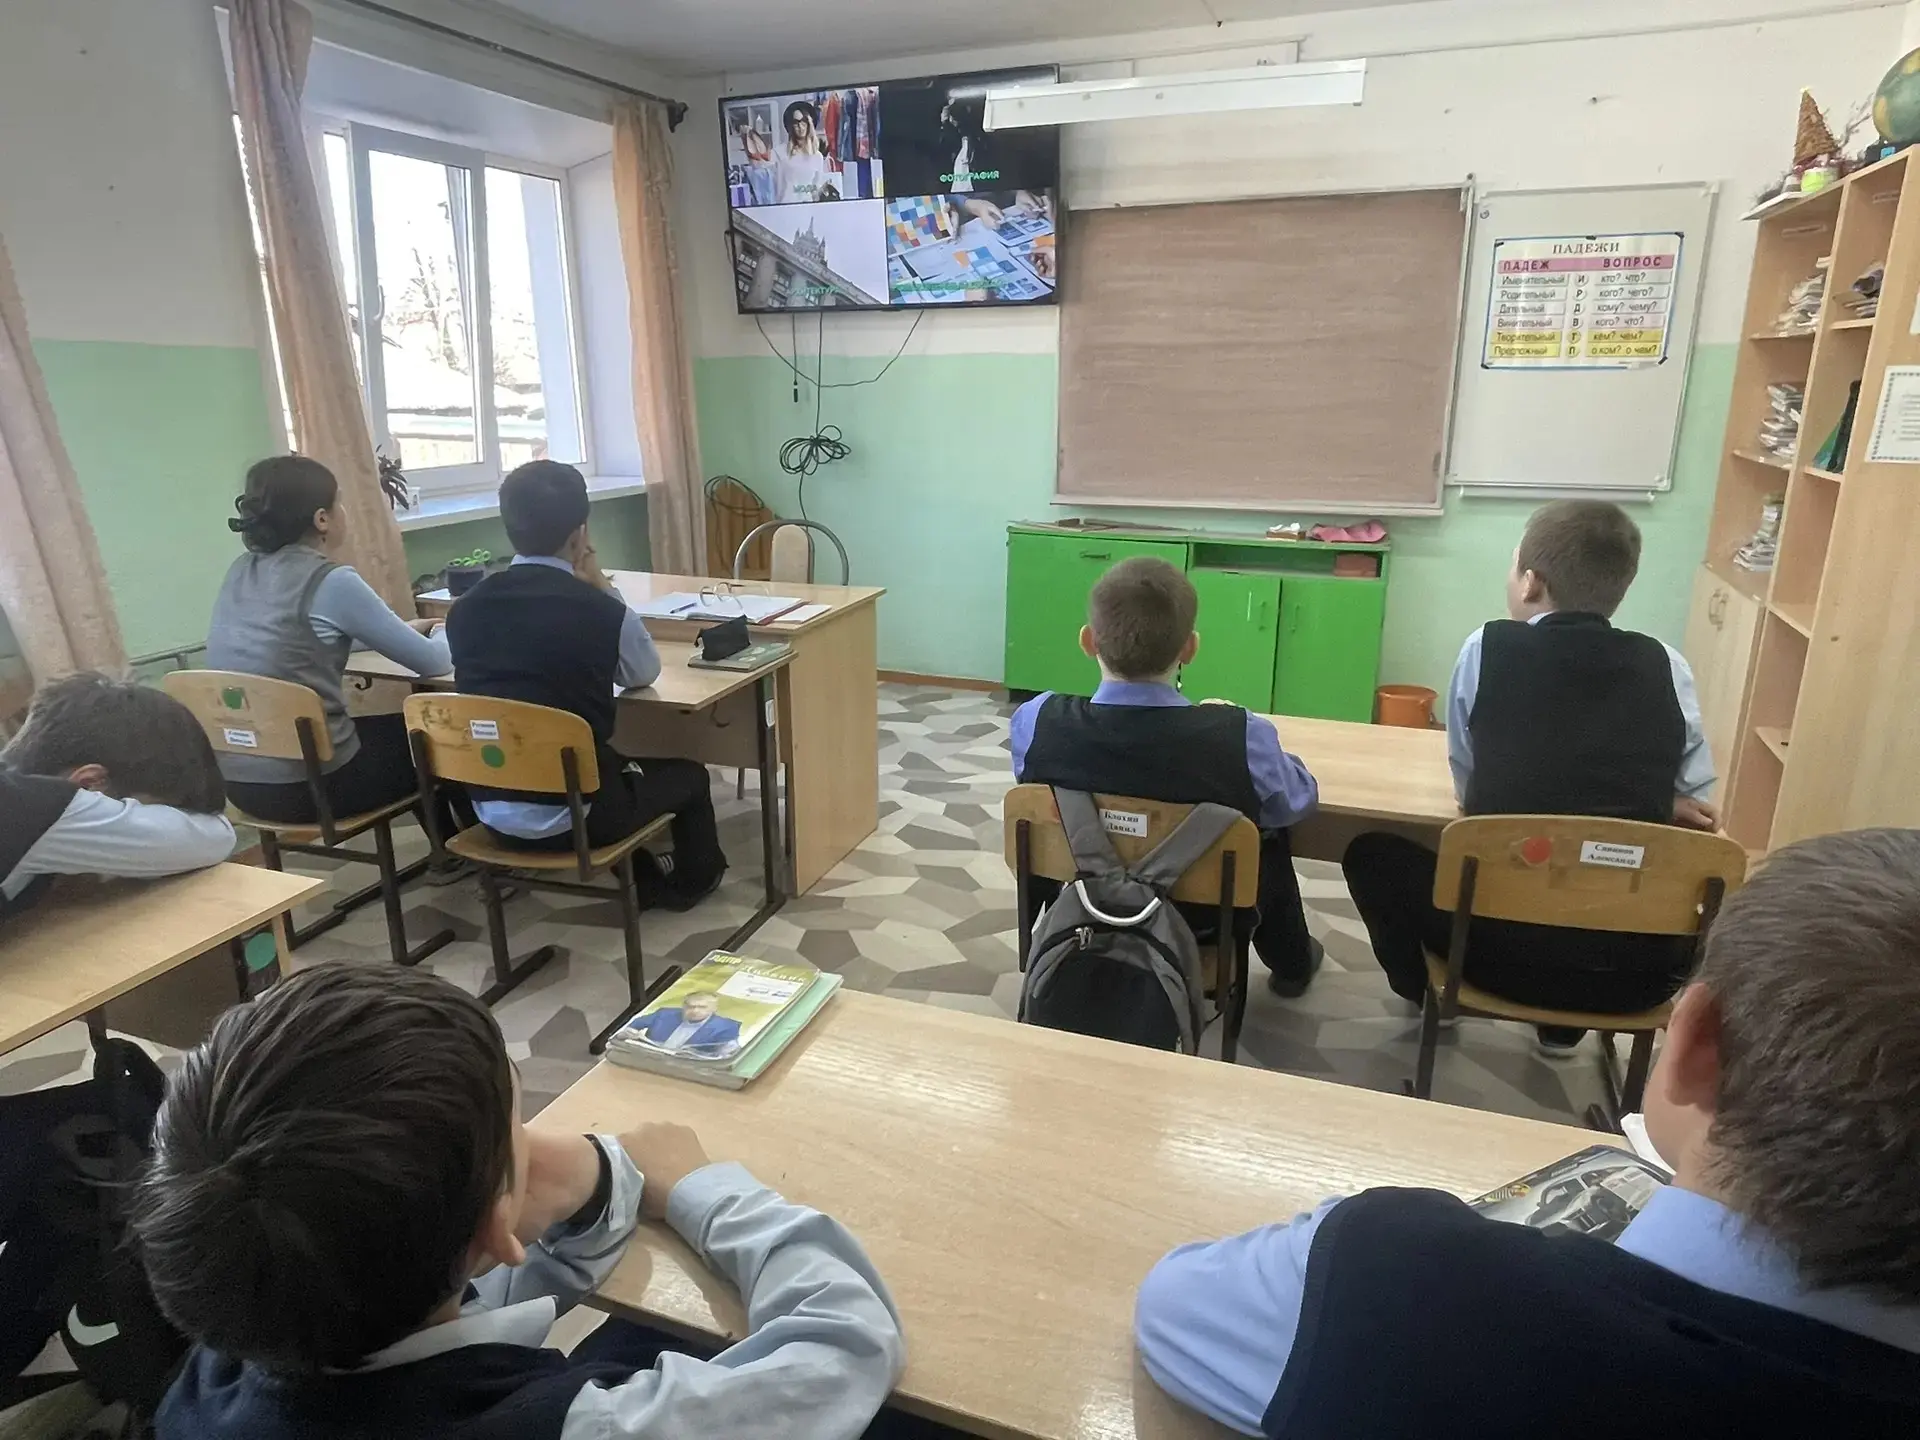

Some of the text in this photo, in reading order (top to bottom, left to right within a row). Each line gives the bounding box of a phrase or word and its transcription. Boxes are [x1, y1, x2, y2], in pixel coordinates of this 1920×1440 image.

[1552, 242, 1619, 255] ПАДЕЖИ
[1503, 256, 1662, 271] ПАДЕЖ ВОПРОС
[1577, 275, 1585, 283] И
[1600, 272, 1622, 283] кто?
[1625, 272, 1646, 283] что?
[1575, 289, 1583, 298] Р
[1599, 287, 1624, 297] кого?
[1628, 287, 1653, 297] чего?
[1573, 304, 1581, 313] Д
[1597, 302, 1624, 314] кому?
[1629, 301, 1657, 313] чему?
[1572, 318, 1579, 327] В
[1595, 316, 1620, 326] кого?
[1624, 316, 1645, 326] что?
[1571, 333, 1577, 341] Т
[1593, 331, 1617, 341] кем?
[1620, 331, 1644, 341] чем?
[1568, 346, 1576, 354] П
[1591, 346, 1597, 354] о
[1599, 345, 1622, 354] ком?
[1626, 346, 1632, 354] о
[1634, 344, 1657, 354] чем?
